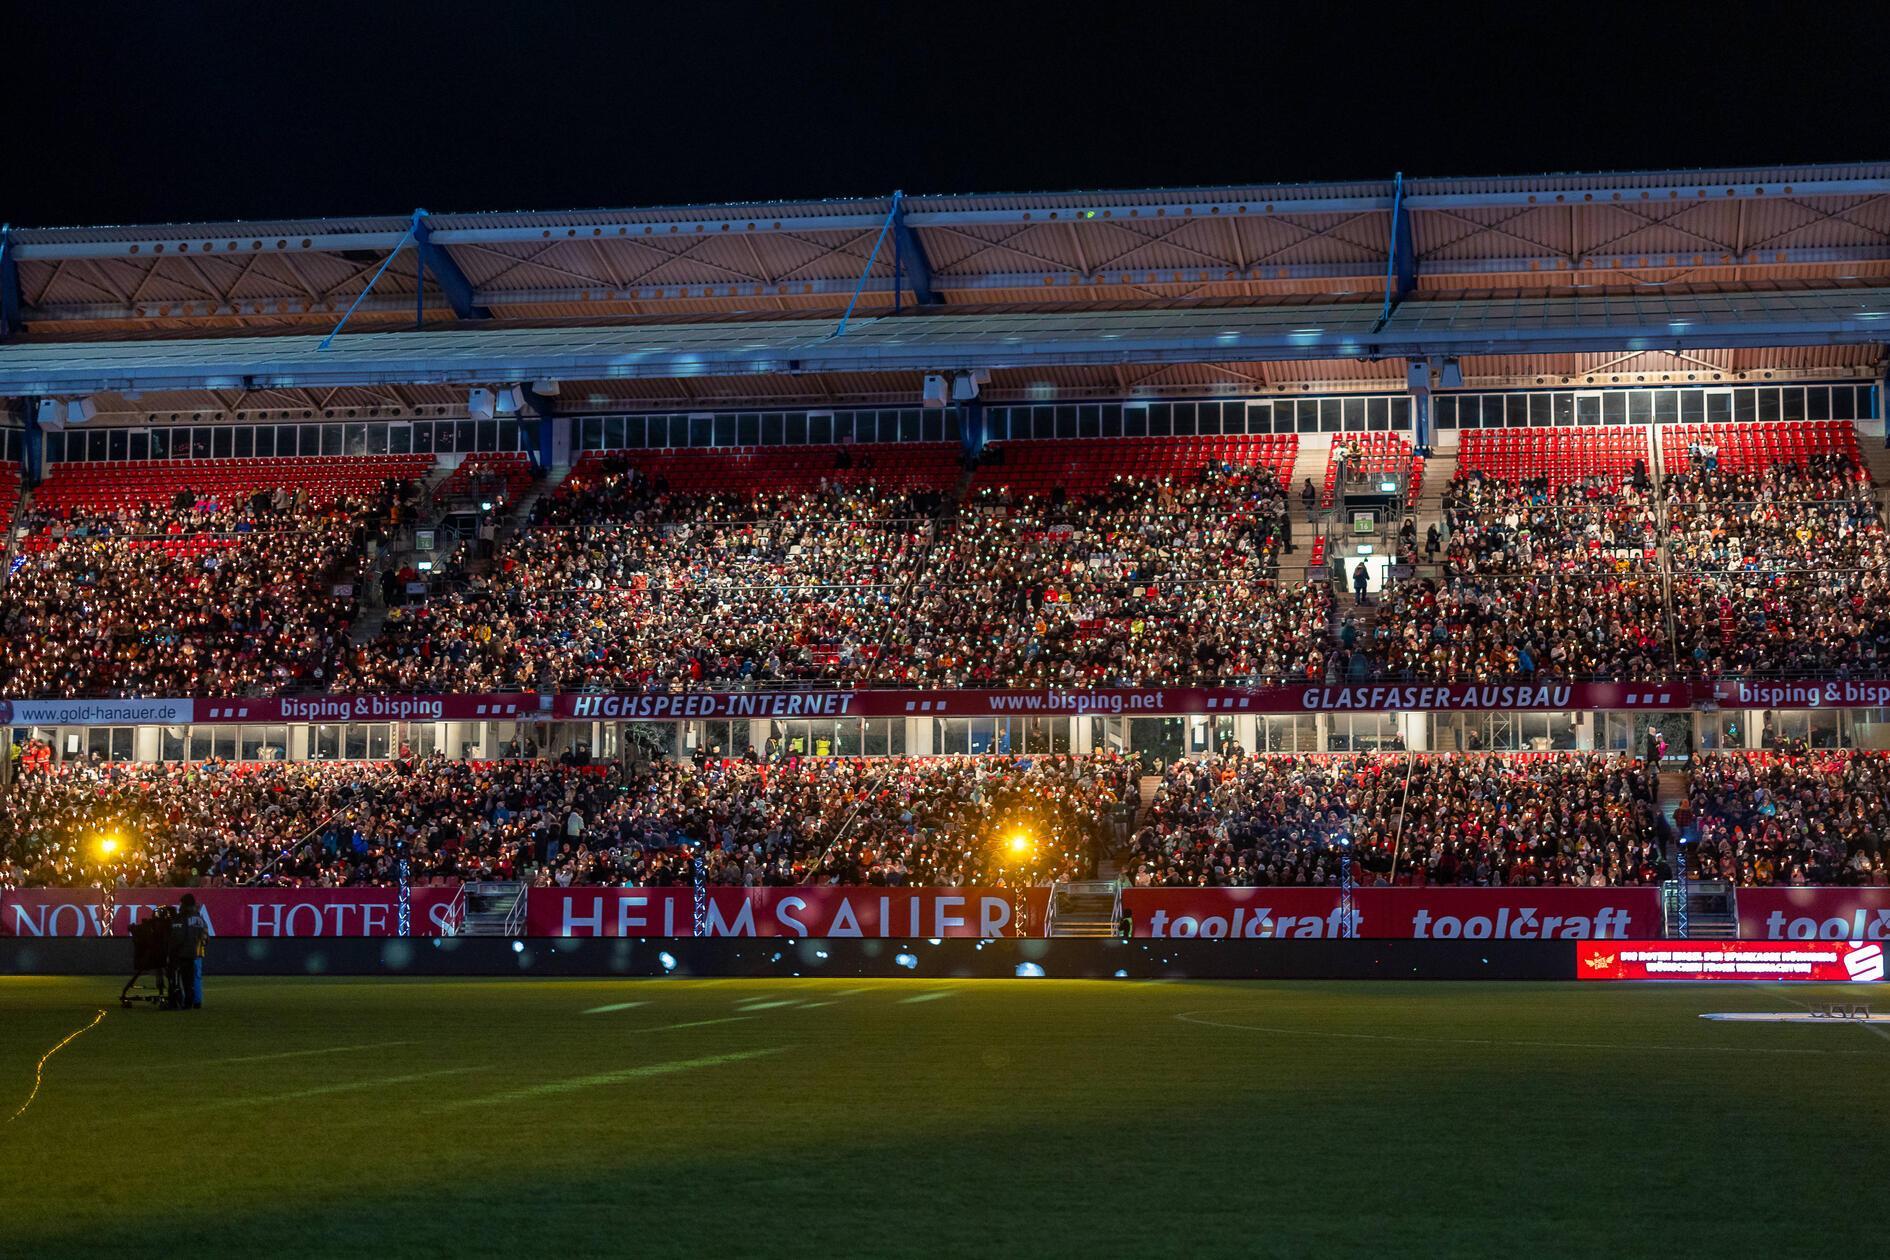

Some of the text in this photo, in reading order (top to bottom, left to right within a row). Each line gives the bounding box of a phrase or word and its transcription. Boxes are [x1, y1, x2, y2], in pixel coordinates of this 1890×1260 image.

[573, 693, 855, 717] HIGHSPEED-INTERNET
[989, 690, 1164, 714] www.bisping.net
[1302, 686, 1571, 709] GLASFASER-AUSBAU
[1738, 683, 1821, 707] bisping
[1825, 682, 1842, 702] &
[22, 705, 177, 723] www.gold-hanauer.de
[281, 697, 443, 720] bisping & bisping
[1413, 907, 1632, 939] toolcraft
